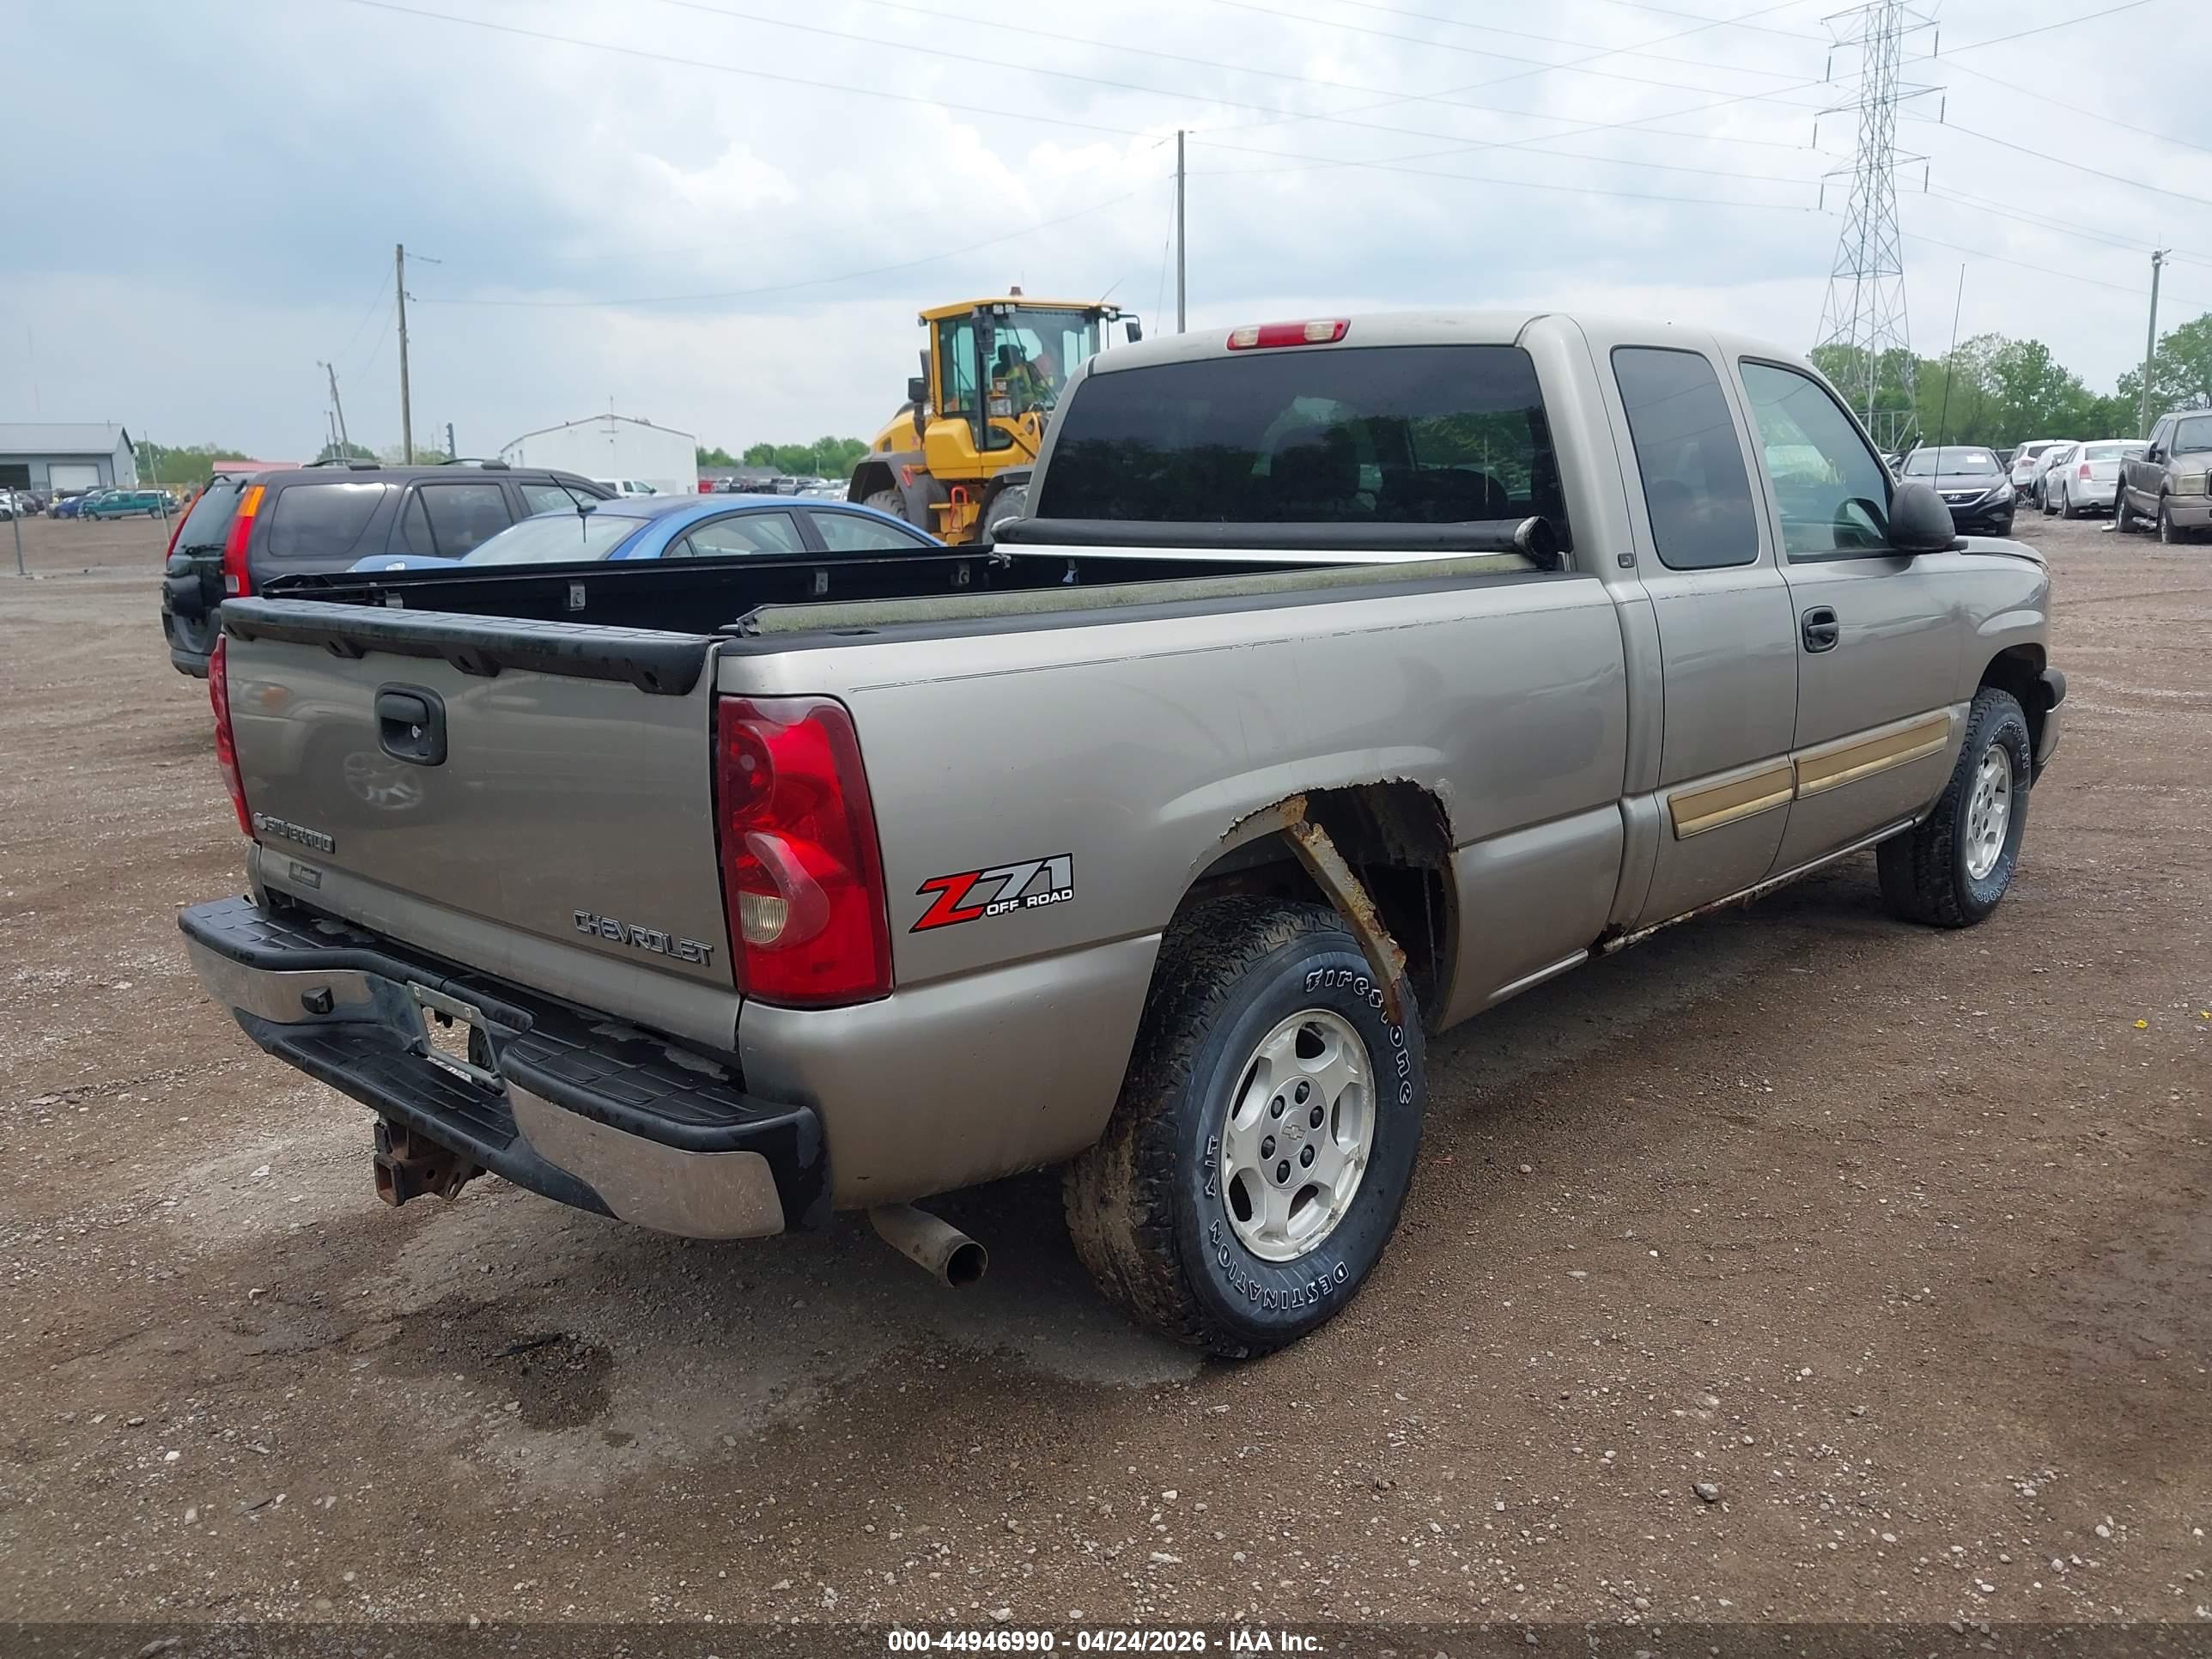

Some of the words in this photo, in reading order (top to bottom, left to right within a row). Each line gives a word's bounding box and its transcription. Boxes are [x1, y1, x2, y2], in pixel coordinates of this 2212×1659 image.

[908, 852, 1073, 933] Z71
[987, 900, 1019, 916] OFF
[1027, 890, 1073, 908] ROAD
[574, 909, 714, 966] CHEVROLET
[1209, 1218, 1350, 1310] DESTINATION
